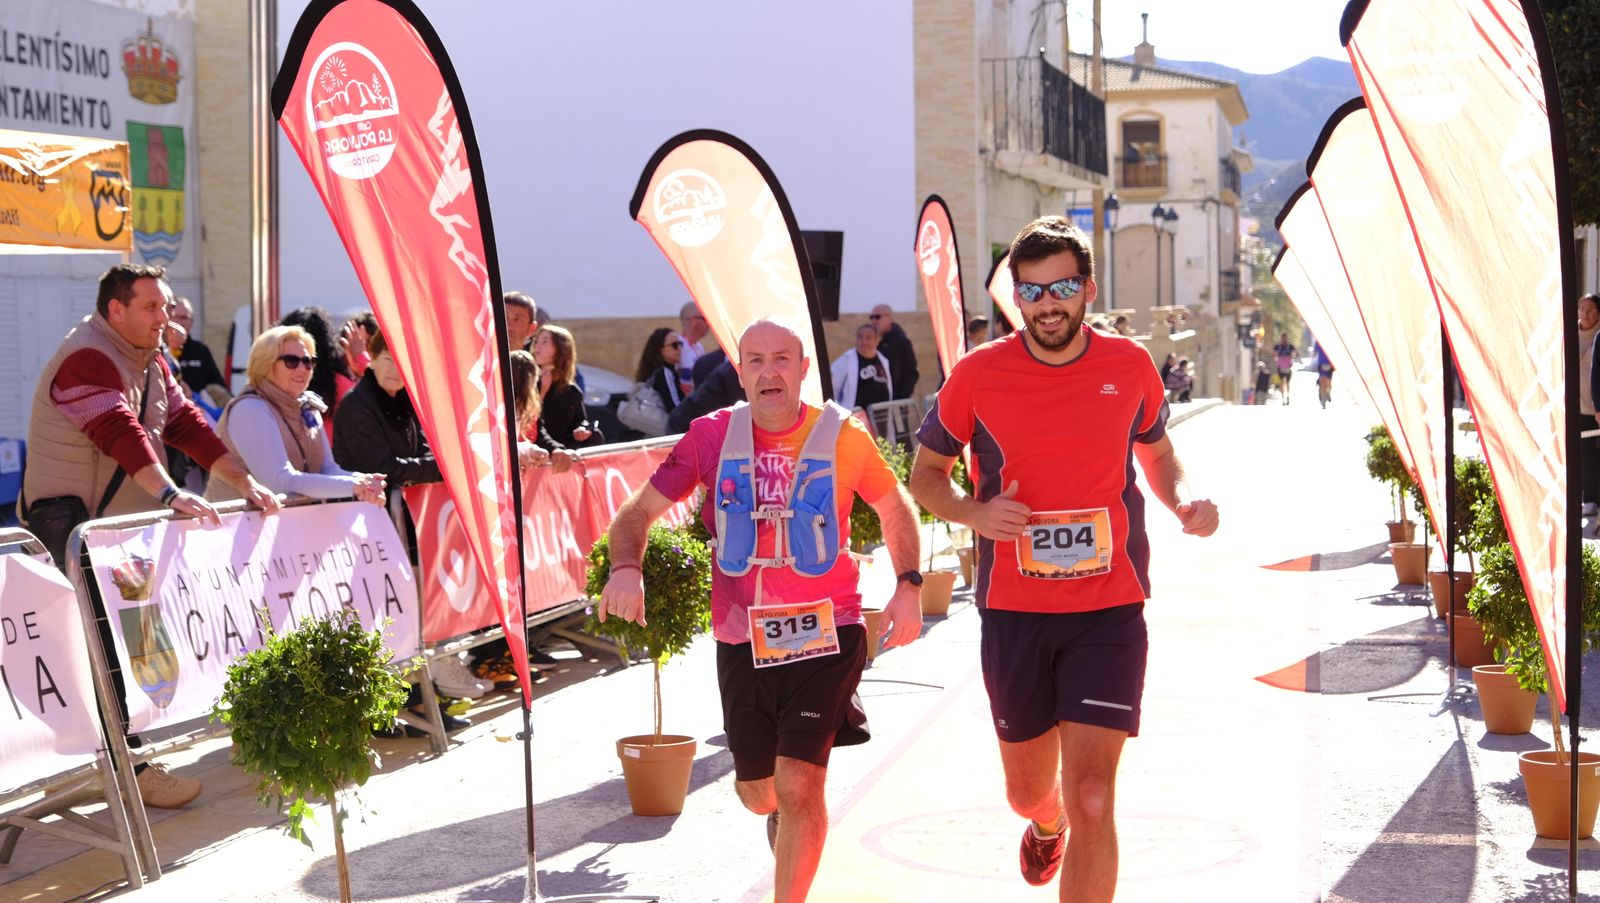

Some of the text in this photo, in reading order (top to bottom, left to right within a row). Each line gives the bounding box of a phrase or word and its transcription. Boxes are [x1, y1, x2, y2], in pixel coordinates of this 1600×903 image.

[0, 29, 109, 78] LENTÍSIMO
[522, 508, 583, 571] OLIA
[1032, 526, 1094, 550] 204
[177, 541, 388, 597] AYUNTAMIENTO DE
[1, 611, 40, 645] DE
[186, 572, 404, 662] CANTORIA
[765, 614, 818, 639] 319
[0, 655, 67, 720] IA
